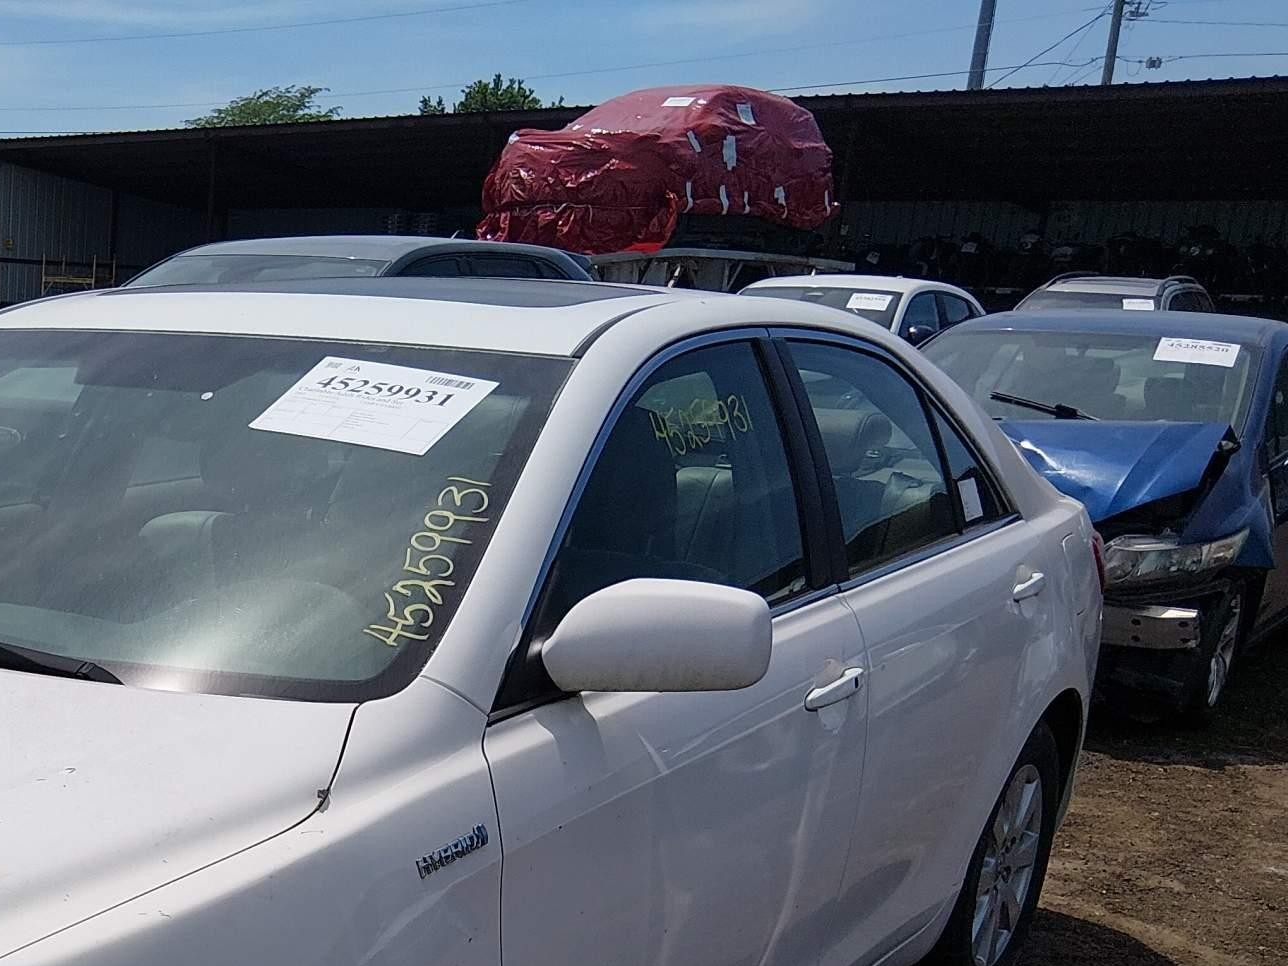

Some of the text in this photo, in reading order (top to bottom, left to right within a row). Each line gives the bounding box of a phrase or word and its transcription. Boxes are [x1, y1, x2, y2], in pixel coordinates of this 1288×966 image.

[316, 375, 456, 408] 45259931
[362, 476, 492, 647] 45259931
[415, 829, 481, 880] HYBRID
